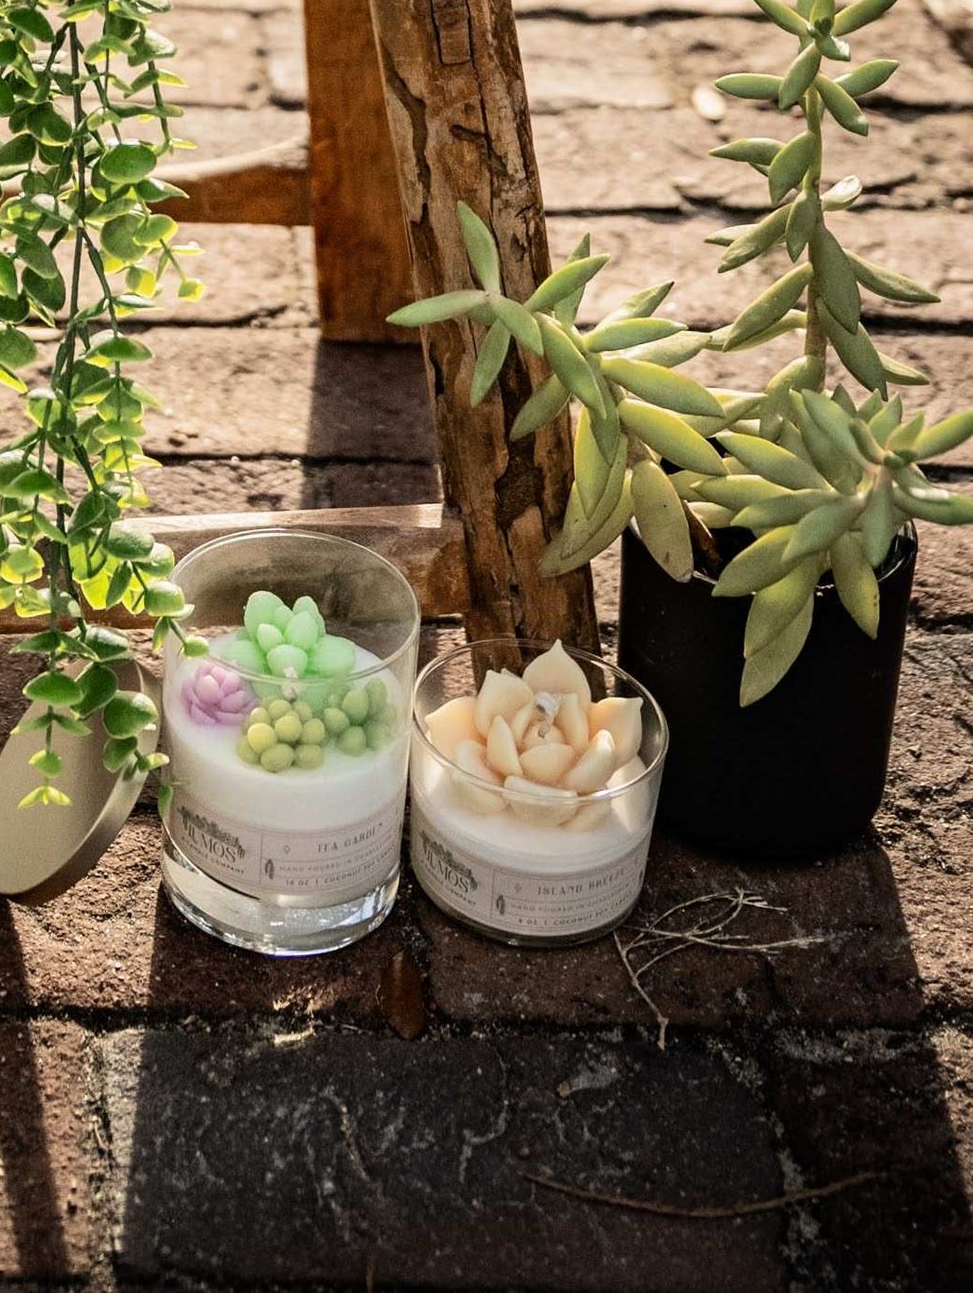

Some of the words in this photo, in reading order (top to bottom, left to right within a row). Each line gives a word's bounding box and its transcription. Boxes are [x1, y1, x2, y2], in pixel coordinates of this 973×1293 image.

[188, 823, 236, 863] LUMOS
[316, 840, 339, 854] TEA
[427, 849, 469, 894] LUMOS
[537, 883, 583, 896] ISLAND
